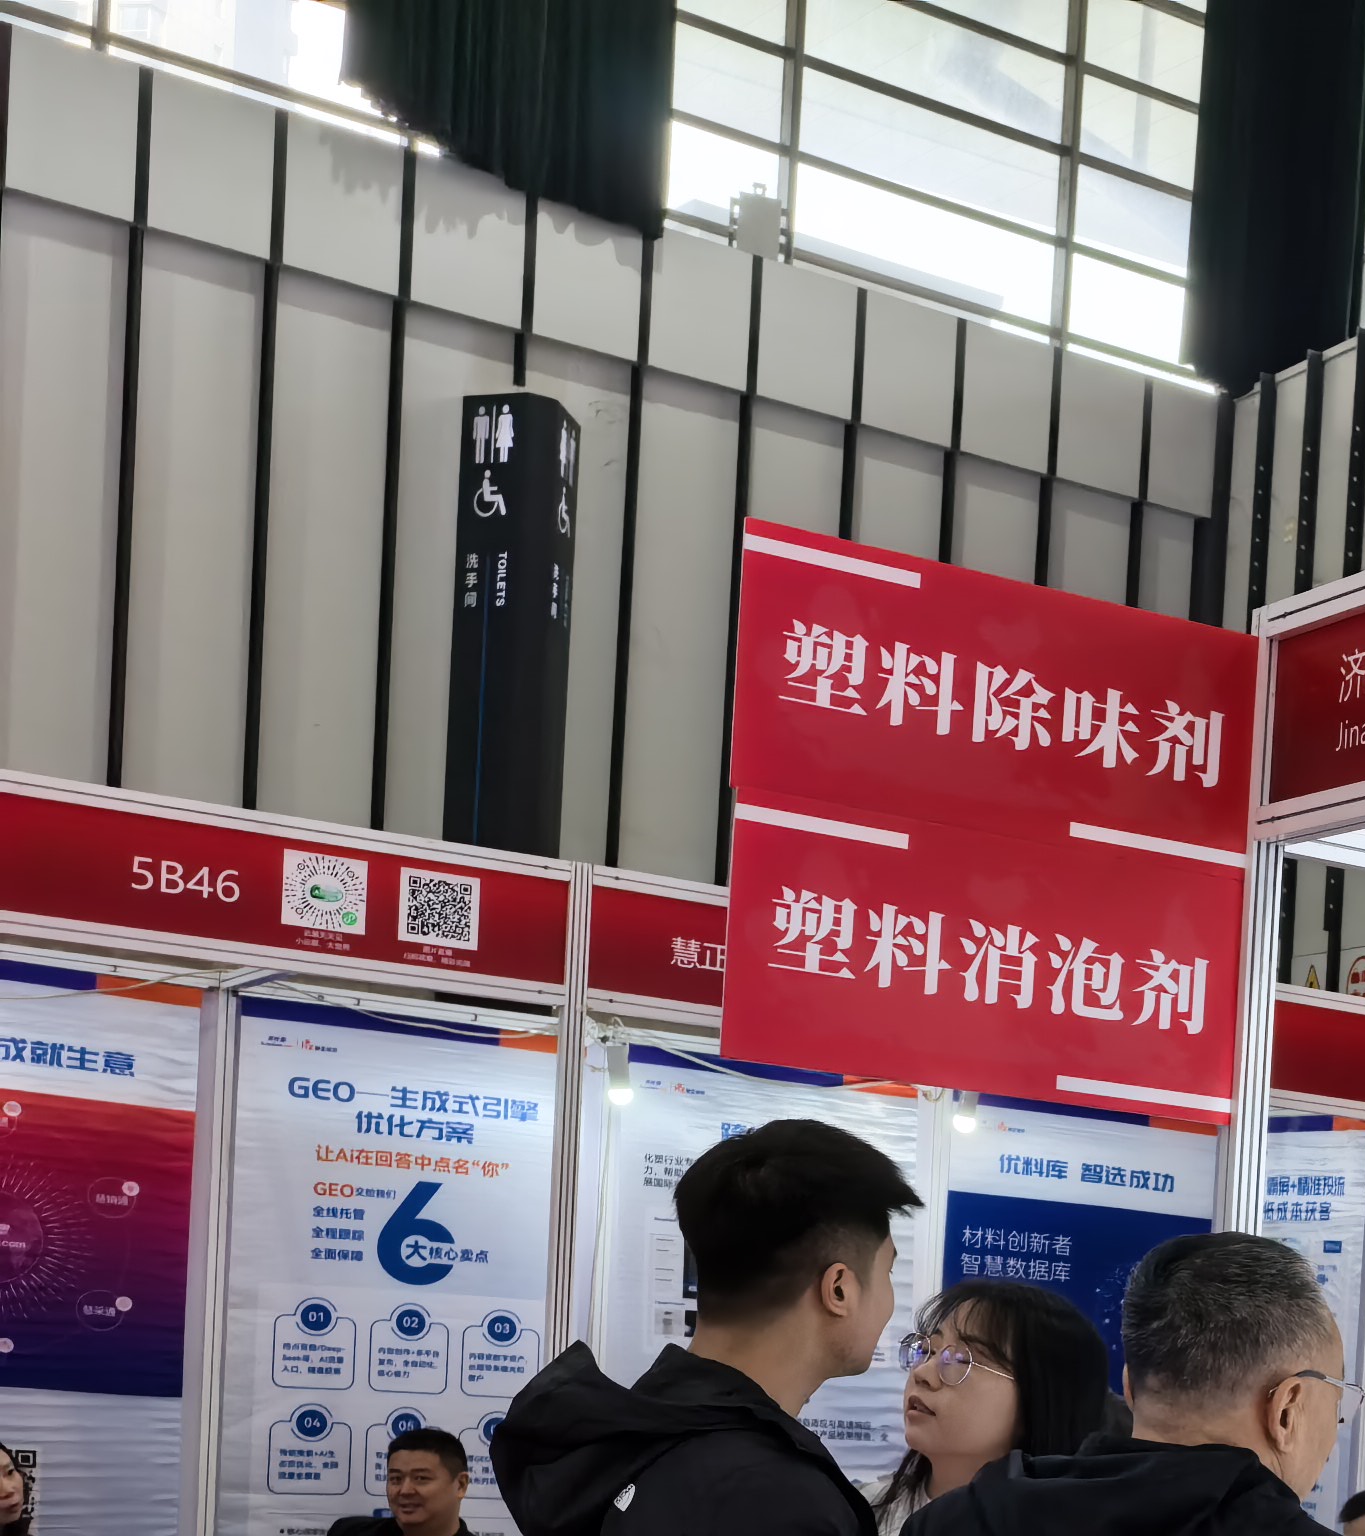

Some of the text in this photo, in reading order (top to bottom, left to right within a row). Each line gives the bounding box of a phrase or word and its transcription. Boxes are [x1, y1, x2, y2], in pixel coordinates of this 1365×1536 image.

[464, 553, 478, 608] 洗手间
[496, 551, 507, 607] TOILETS
[779, 619, 1225, 788] 塑料除味剂
[130, 855, 241, 904] 5B46
[671, 936, 726, 971] 慧正
[768, 885, 1209, 1035] 塑料消泡剂
[355, 1110, 475, 1145] 优化方案
[999, 1153, 1175, 1194] 优料库 智选成功
[961, 1225, 1072, 1257] 材料创新者
[960, 1252, 1072, 1283] 智慧数据库
[308, 1311, 325, 1323] 01
[403, 1316, 419, 1329] 02
[494, 1322, 511, 1335] 03
[304, 1417, 321, 1430] 04
